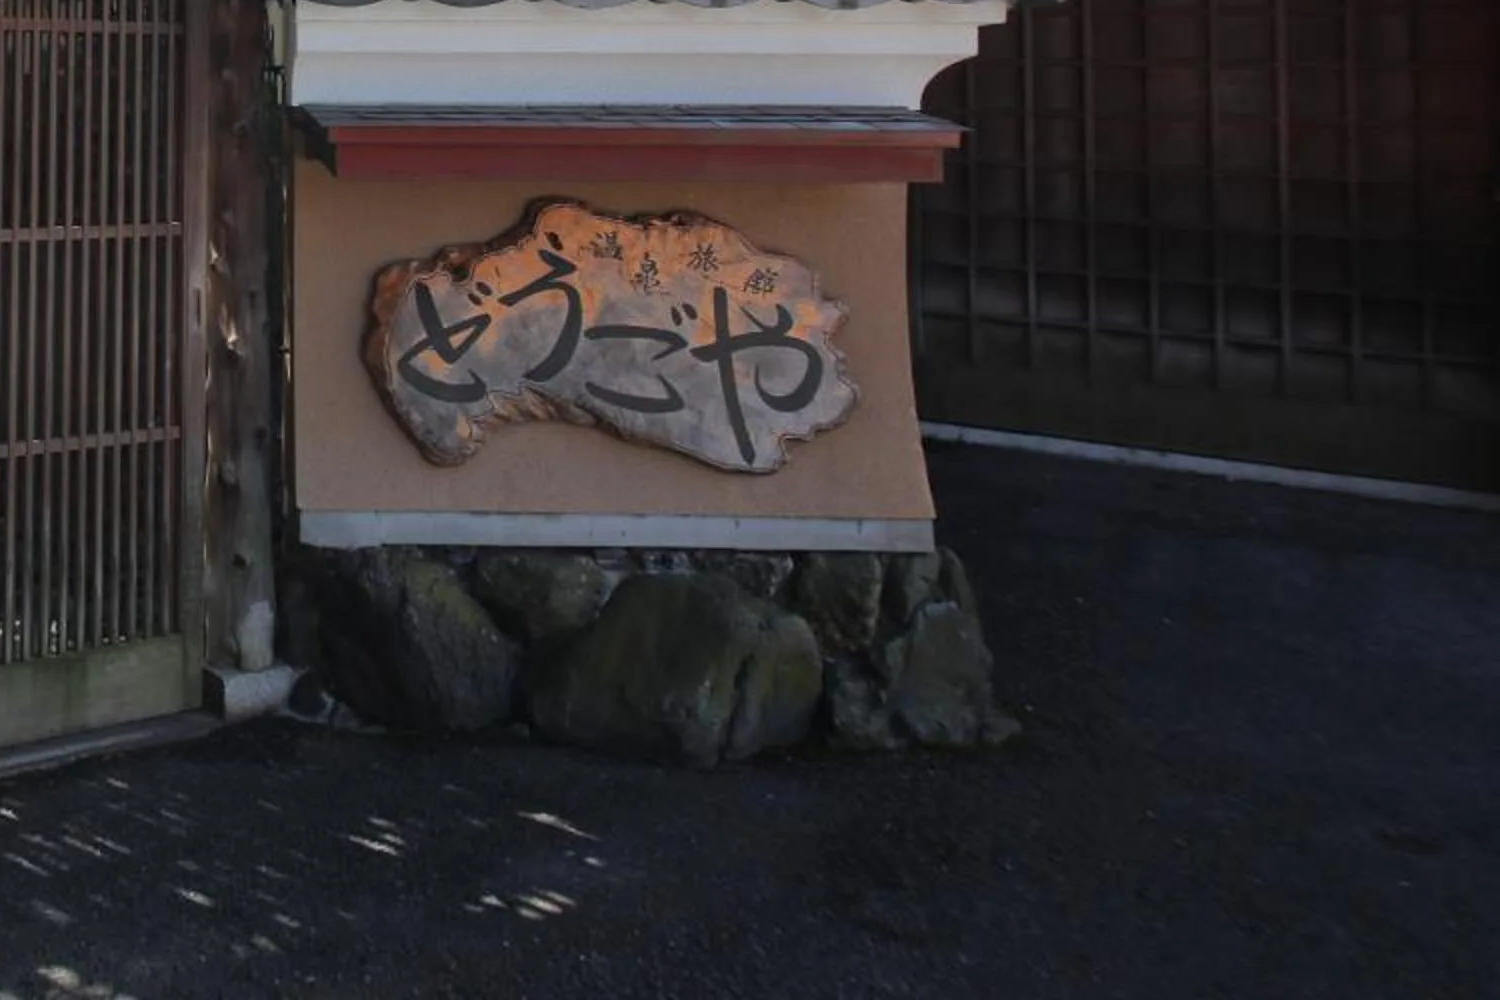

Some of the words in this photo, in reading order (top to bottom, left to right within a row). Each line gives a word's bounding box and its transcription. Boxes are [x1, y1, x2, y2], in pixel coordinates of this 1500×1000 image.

[580, 231, 779, 295] 温泉旅館
[397, 249, 823, 465] どうごや
